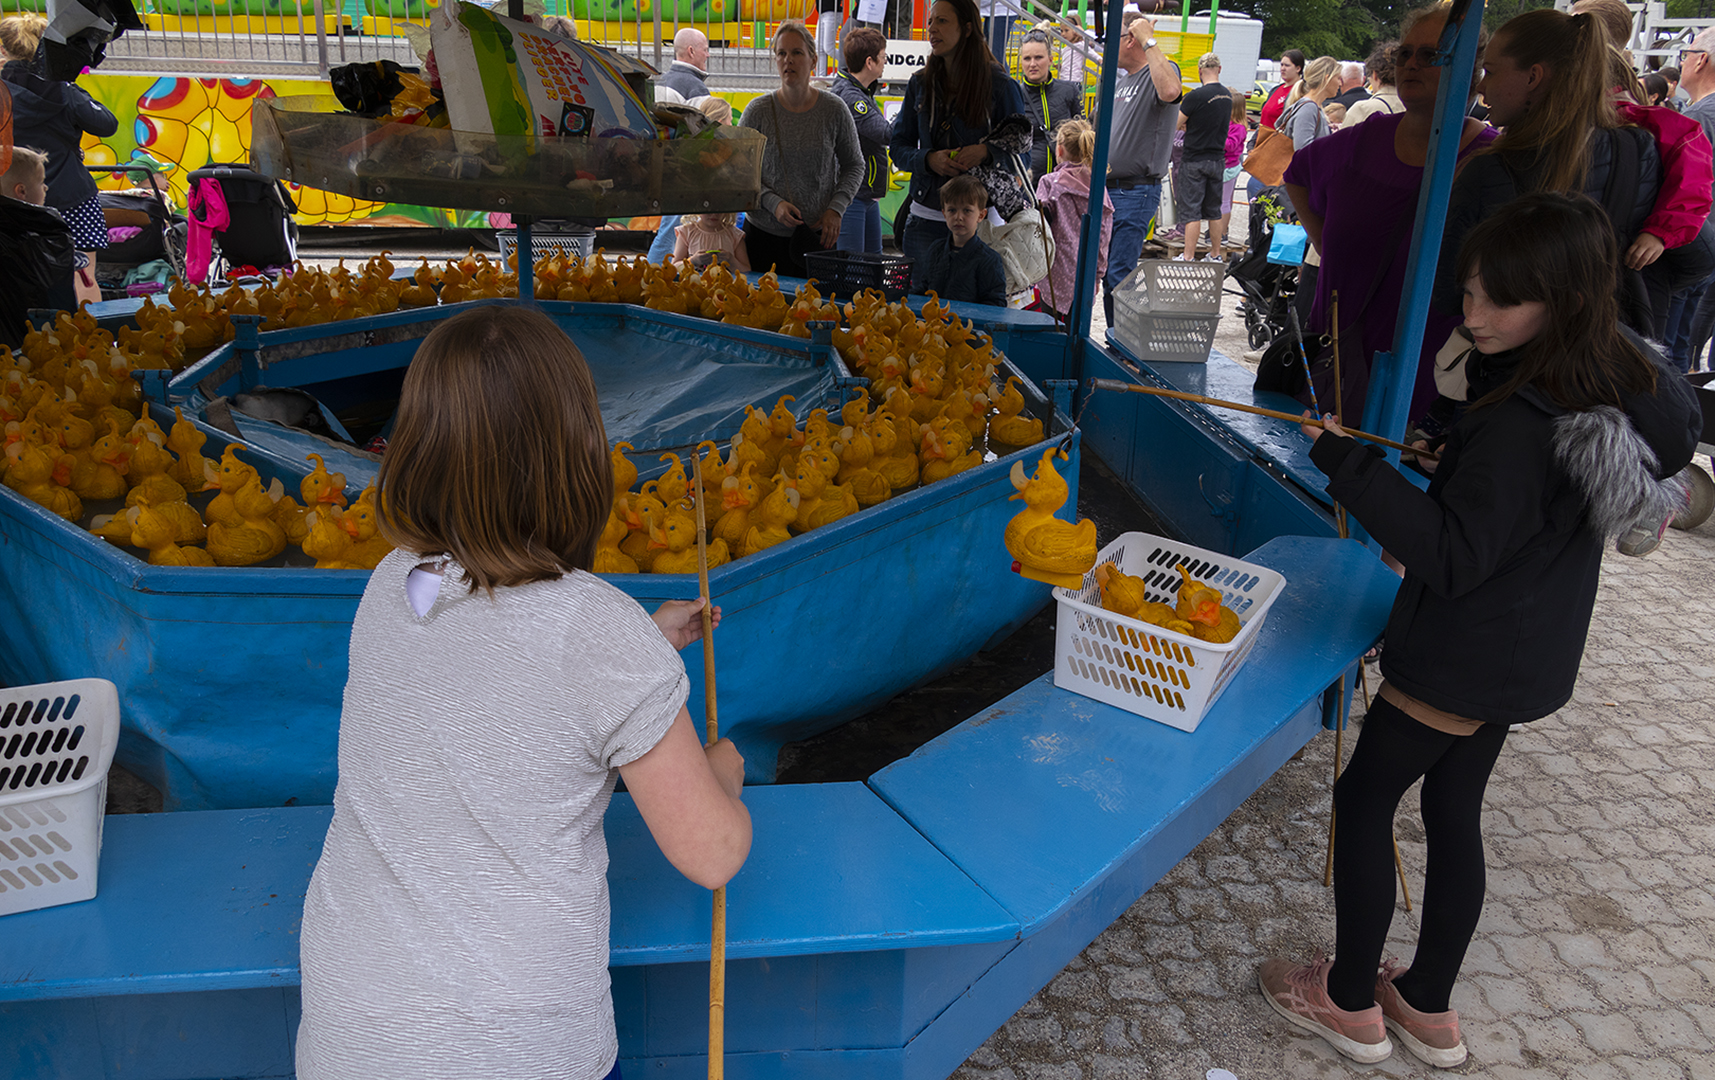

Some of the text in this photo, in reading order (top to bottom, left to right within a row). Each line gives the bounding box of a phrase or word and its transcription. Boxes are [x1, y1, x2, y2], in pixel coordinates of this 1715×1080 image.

[518, 31, 559, 101] VLIEGER
[541, 37, 586, 105] CERF-VO
[560, 50, 590, 86] KITE
[884, 54, 926, 66] NDGA
